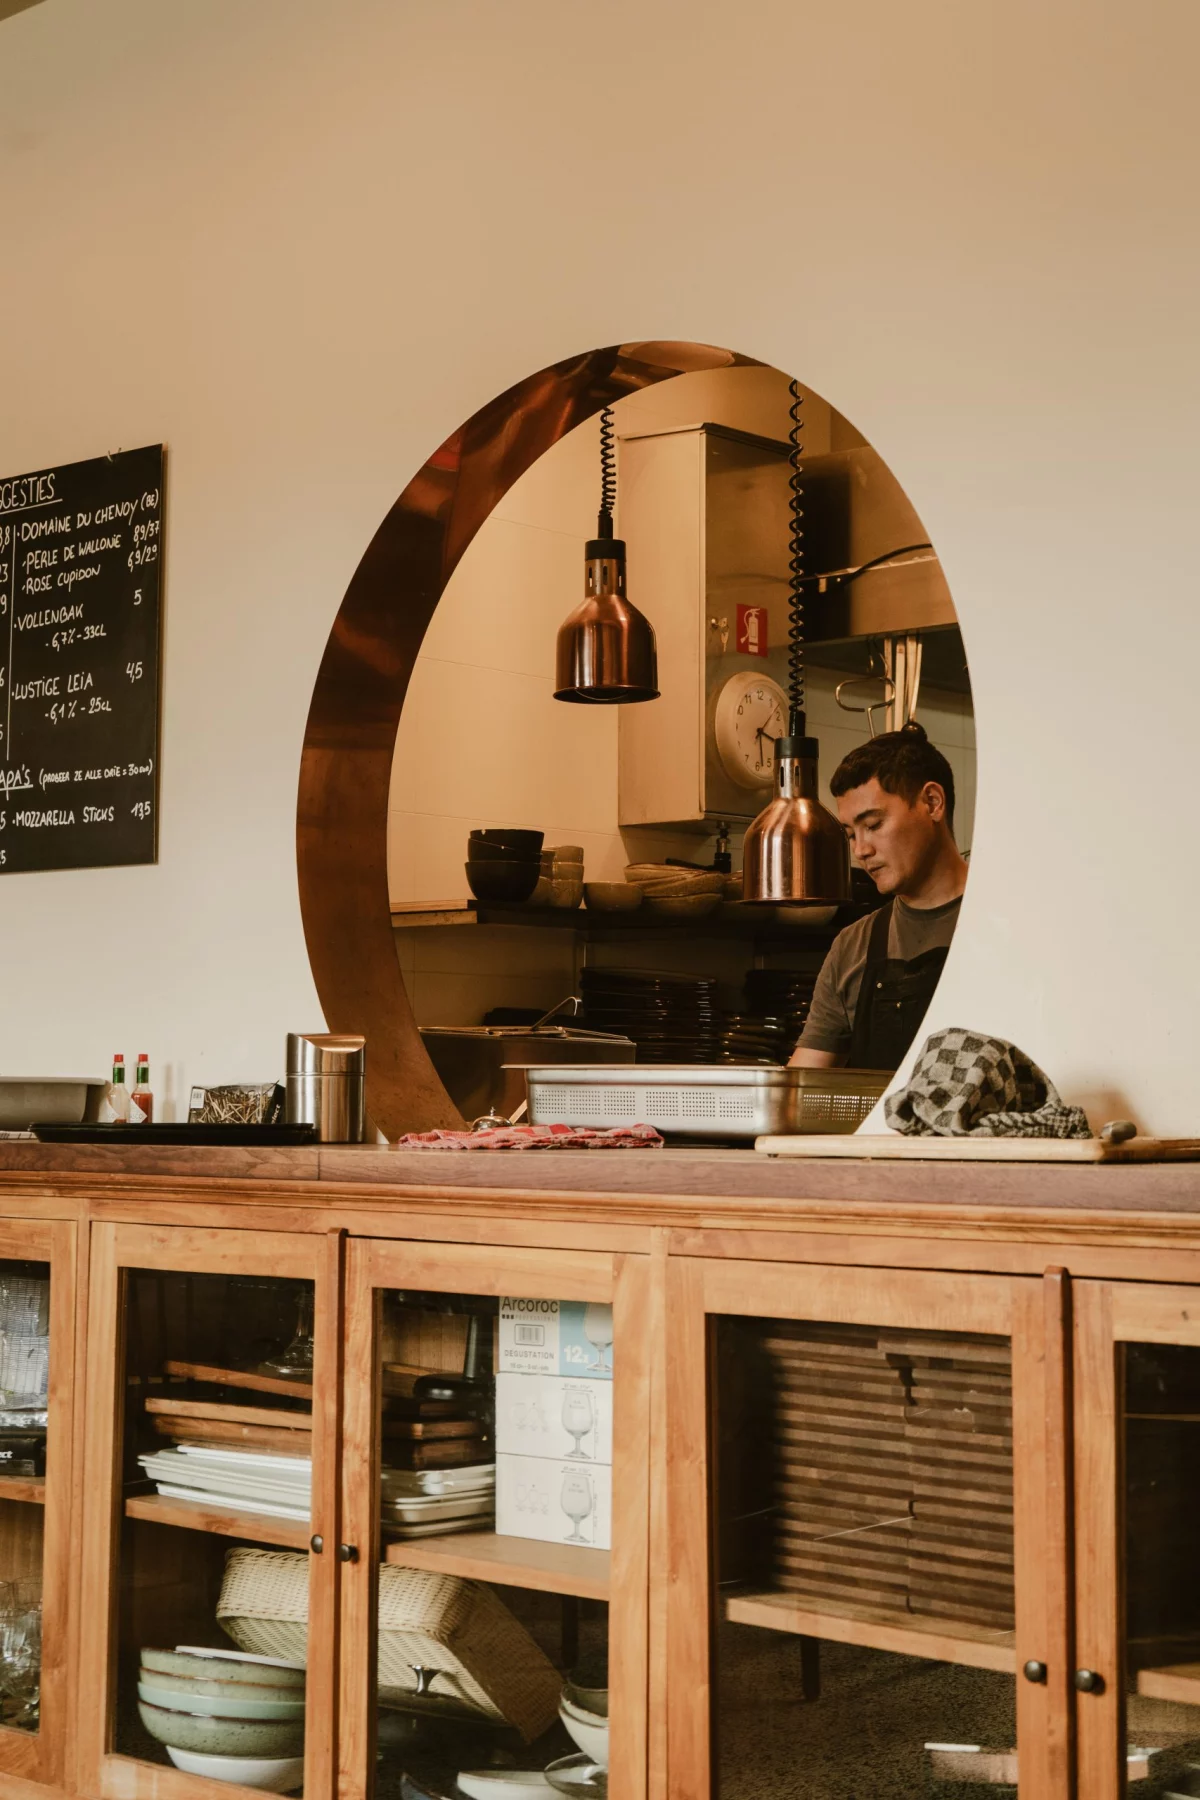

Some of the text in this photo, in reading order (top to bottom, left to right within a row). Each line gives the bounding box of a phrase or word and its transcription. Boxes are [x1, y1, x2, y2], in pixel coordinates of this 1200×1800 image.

[0, 473, 56, 510] GESTIES
[76, 511, 92, 529] DU
[94, 499, 139, 526] CHENOY
[140, 488, 159, 511] (BE)
[26, 549, 59, 575] PERLE
[63, 544, 76, 562] DE
[26, 574, 53, 595] ROSE
[133, 588, 142, 606] 5
[126, 661, 143, 684] 4,5
[84, 769, 102, 781] ALLE
[15, 808, 76, 828] MOZZARELLA
[501, 1296, 559, 1314] Arcoroc
